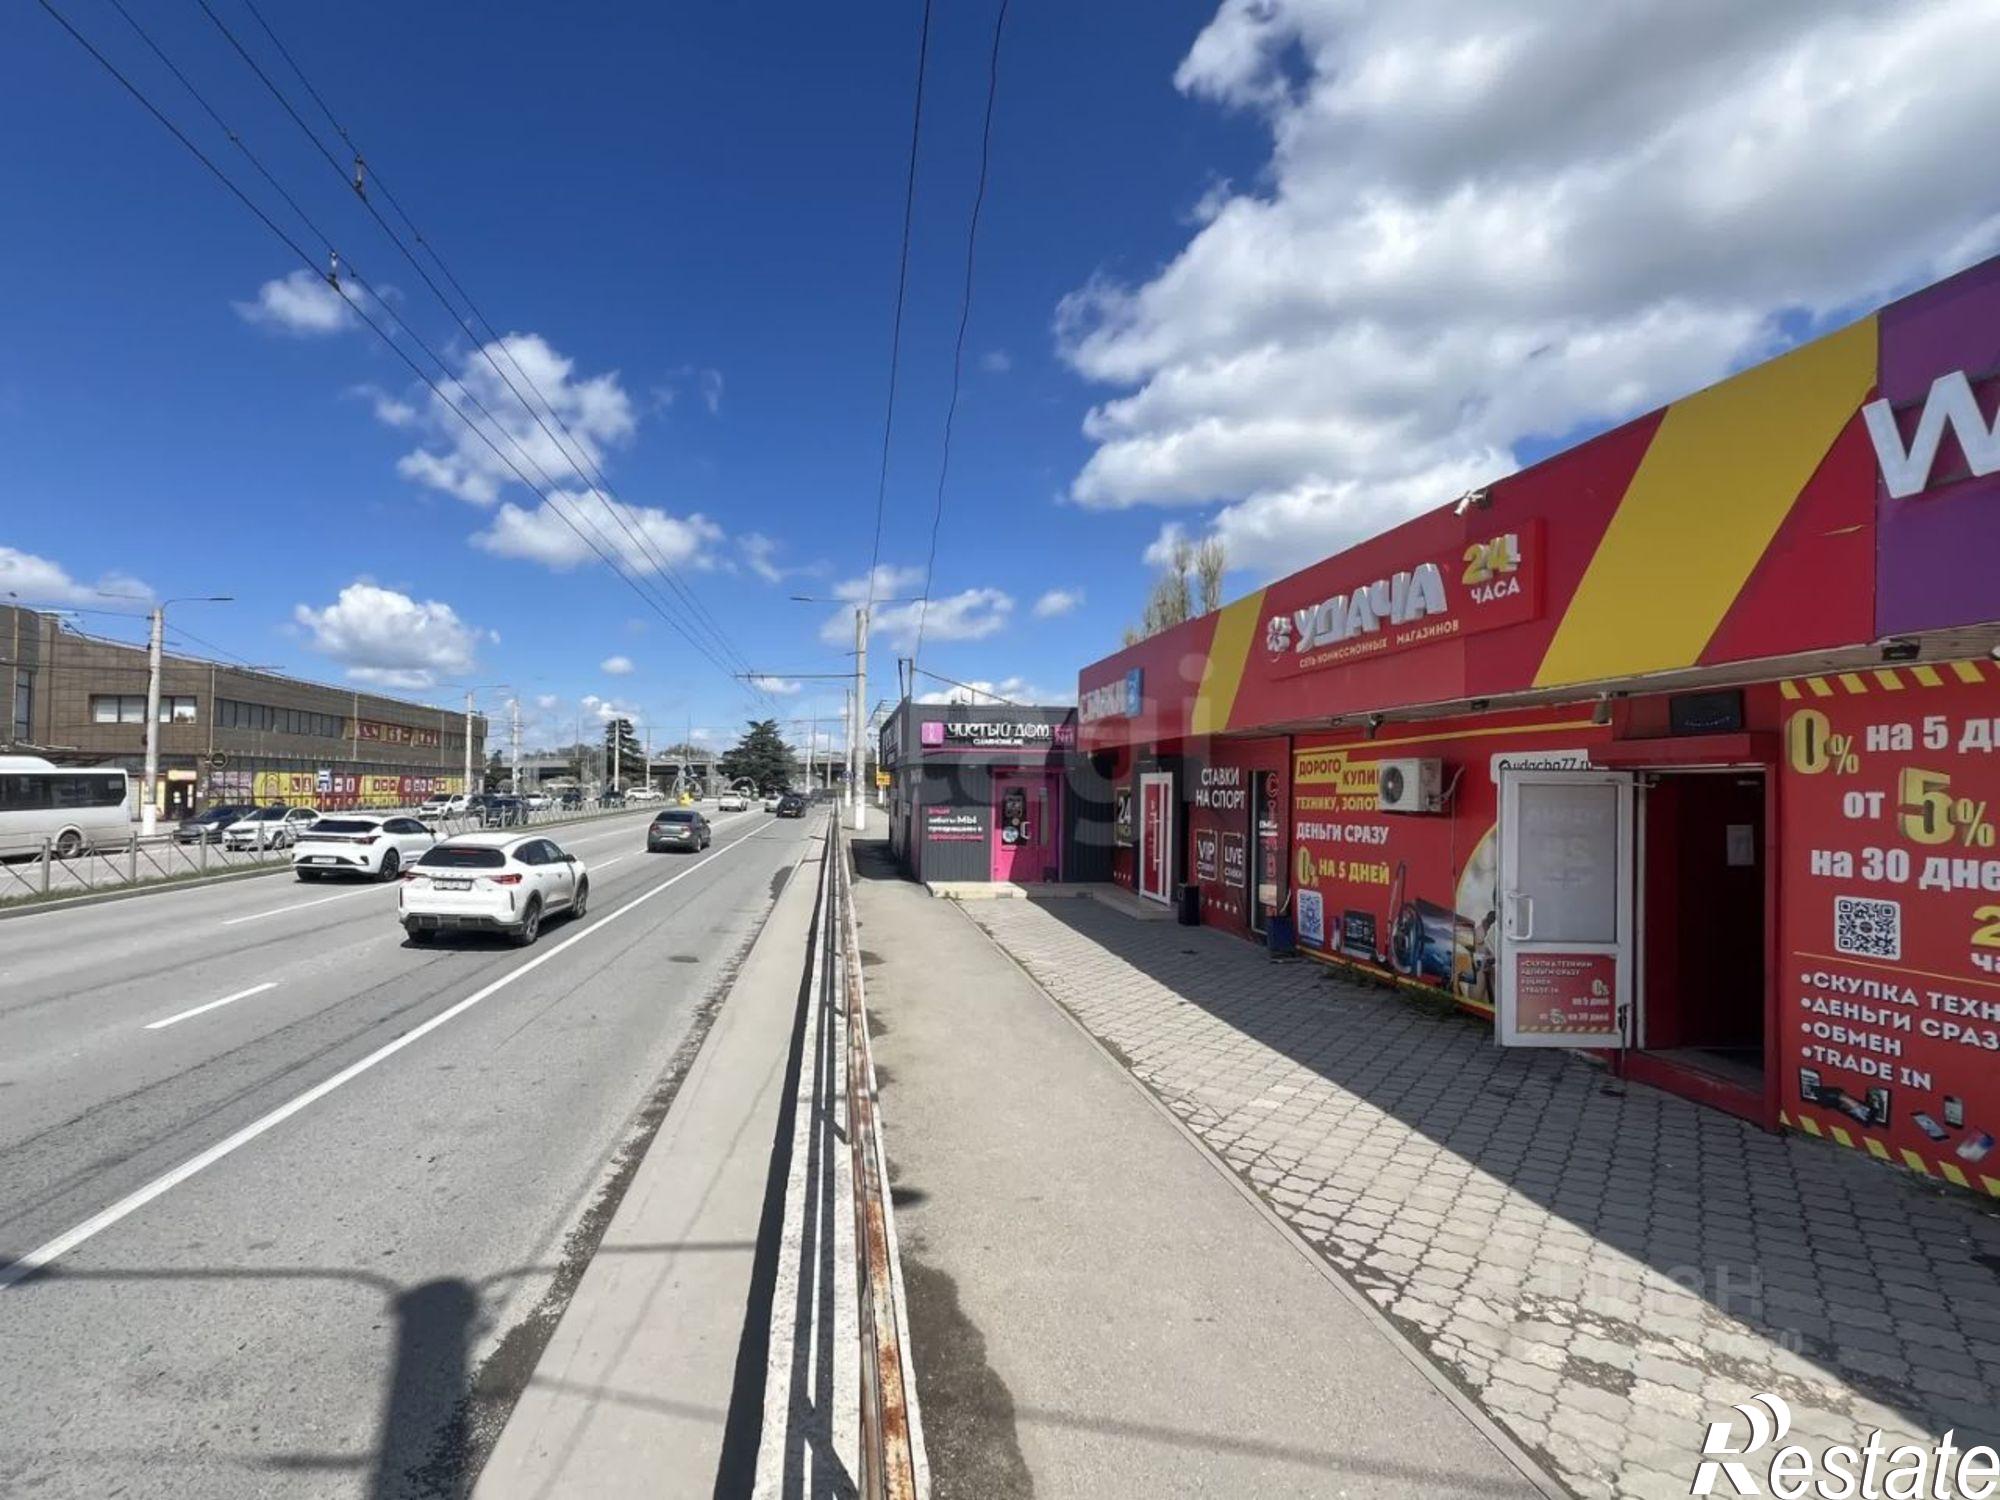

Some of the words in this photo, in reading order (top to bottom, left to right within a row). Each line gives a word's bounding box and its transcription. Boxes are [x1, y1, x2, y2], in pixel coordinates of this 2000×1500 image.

[1462, 533, 1521, 585] 24
[1471, 576, 1520, 604] ЧАСА
[1294, 562, 1448, 653] УДАЧА
[1396, 619, 1459, 645] МАГАЗИНОВ
[1785, 709, 1859, 775] 0%
[1866, 723, 1913, 752] на
[1923, 715, 1948, 749] 5
[1958, 718, 2000, 754] д
[1201, 767, 1240, 786] СТАВКИ
[1298, 758, 1341, 776] ДОРОГО
[1117, 796, 1131, 825] 24
[1196, 789, 1210, 808] НА
[1212, 790, 1245, 809] СПОРТ
[1843, 791, 1885, 819] от
[1898, 767, 1995, 848] 5%
[1296, 822, 1342, 841] ДЕНЬГИ
[1344, 825, 1389, 845] СРАЗУ
[1319, 858, 1336, 877] НА
[1338, 861, 1347, 878] 5
[1349, 861, 1390, 885] ДНЕЙ
[1811, 849, 1853, 878] на
[1861, 846, 1910, 883] 30
[1813, 972, 1919, 1007] СКУПКА
[1812, 997, 1911, 1031] ДЕНЬГИ
[1813, 1022, 1901, 1057] ОБМЕН
[1814, 1045, 1893, 1081] TRADE
[1900, 1066, 1932, 1091] IN
